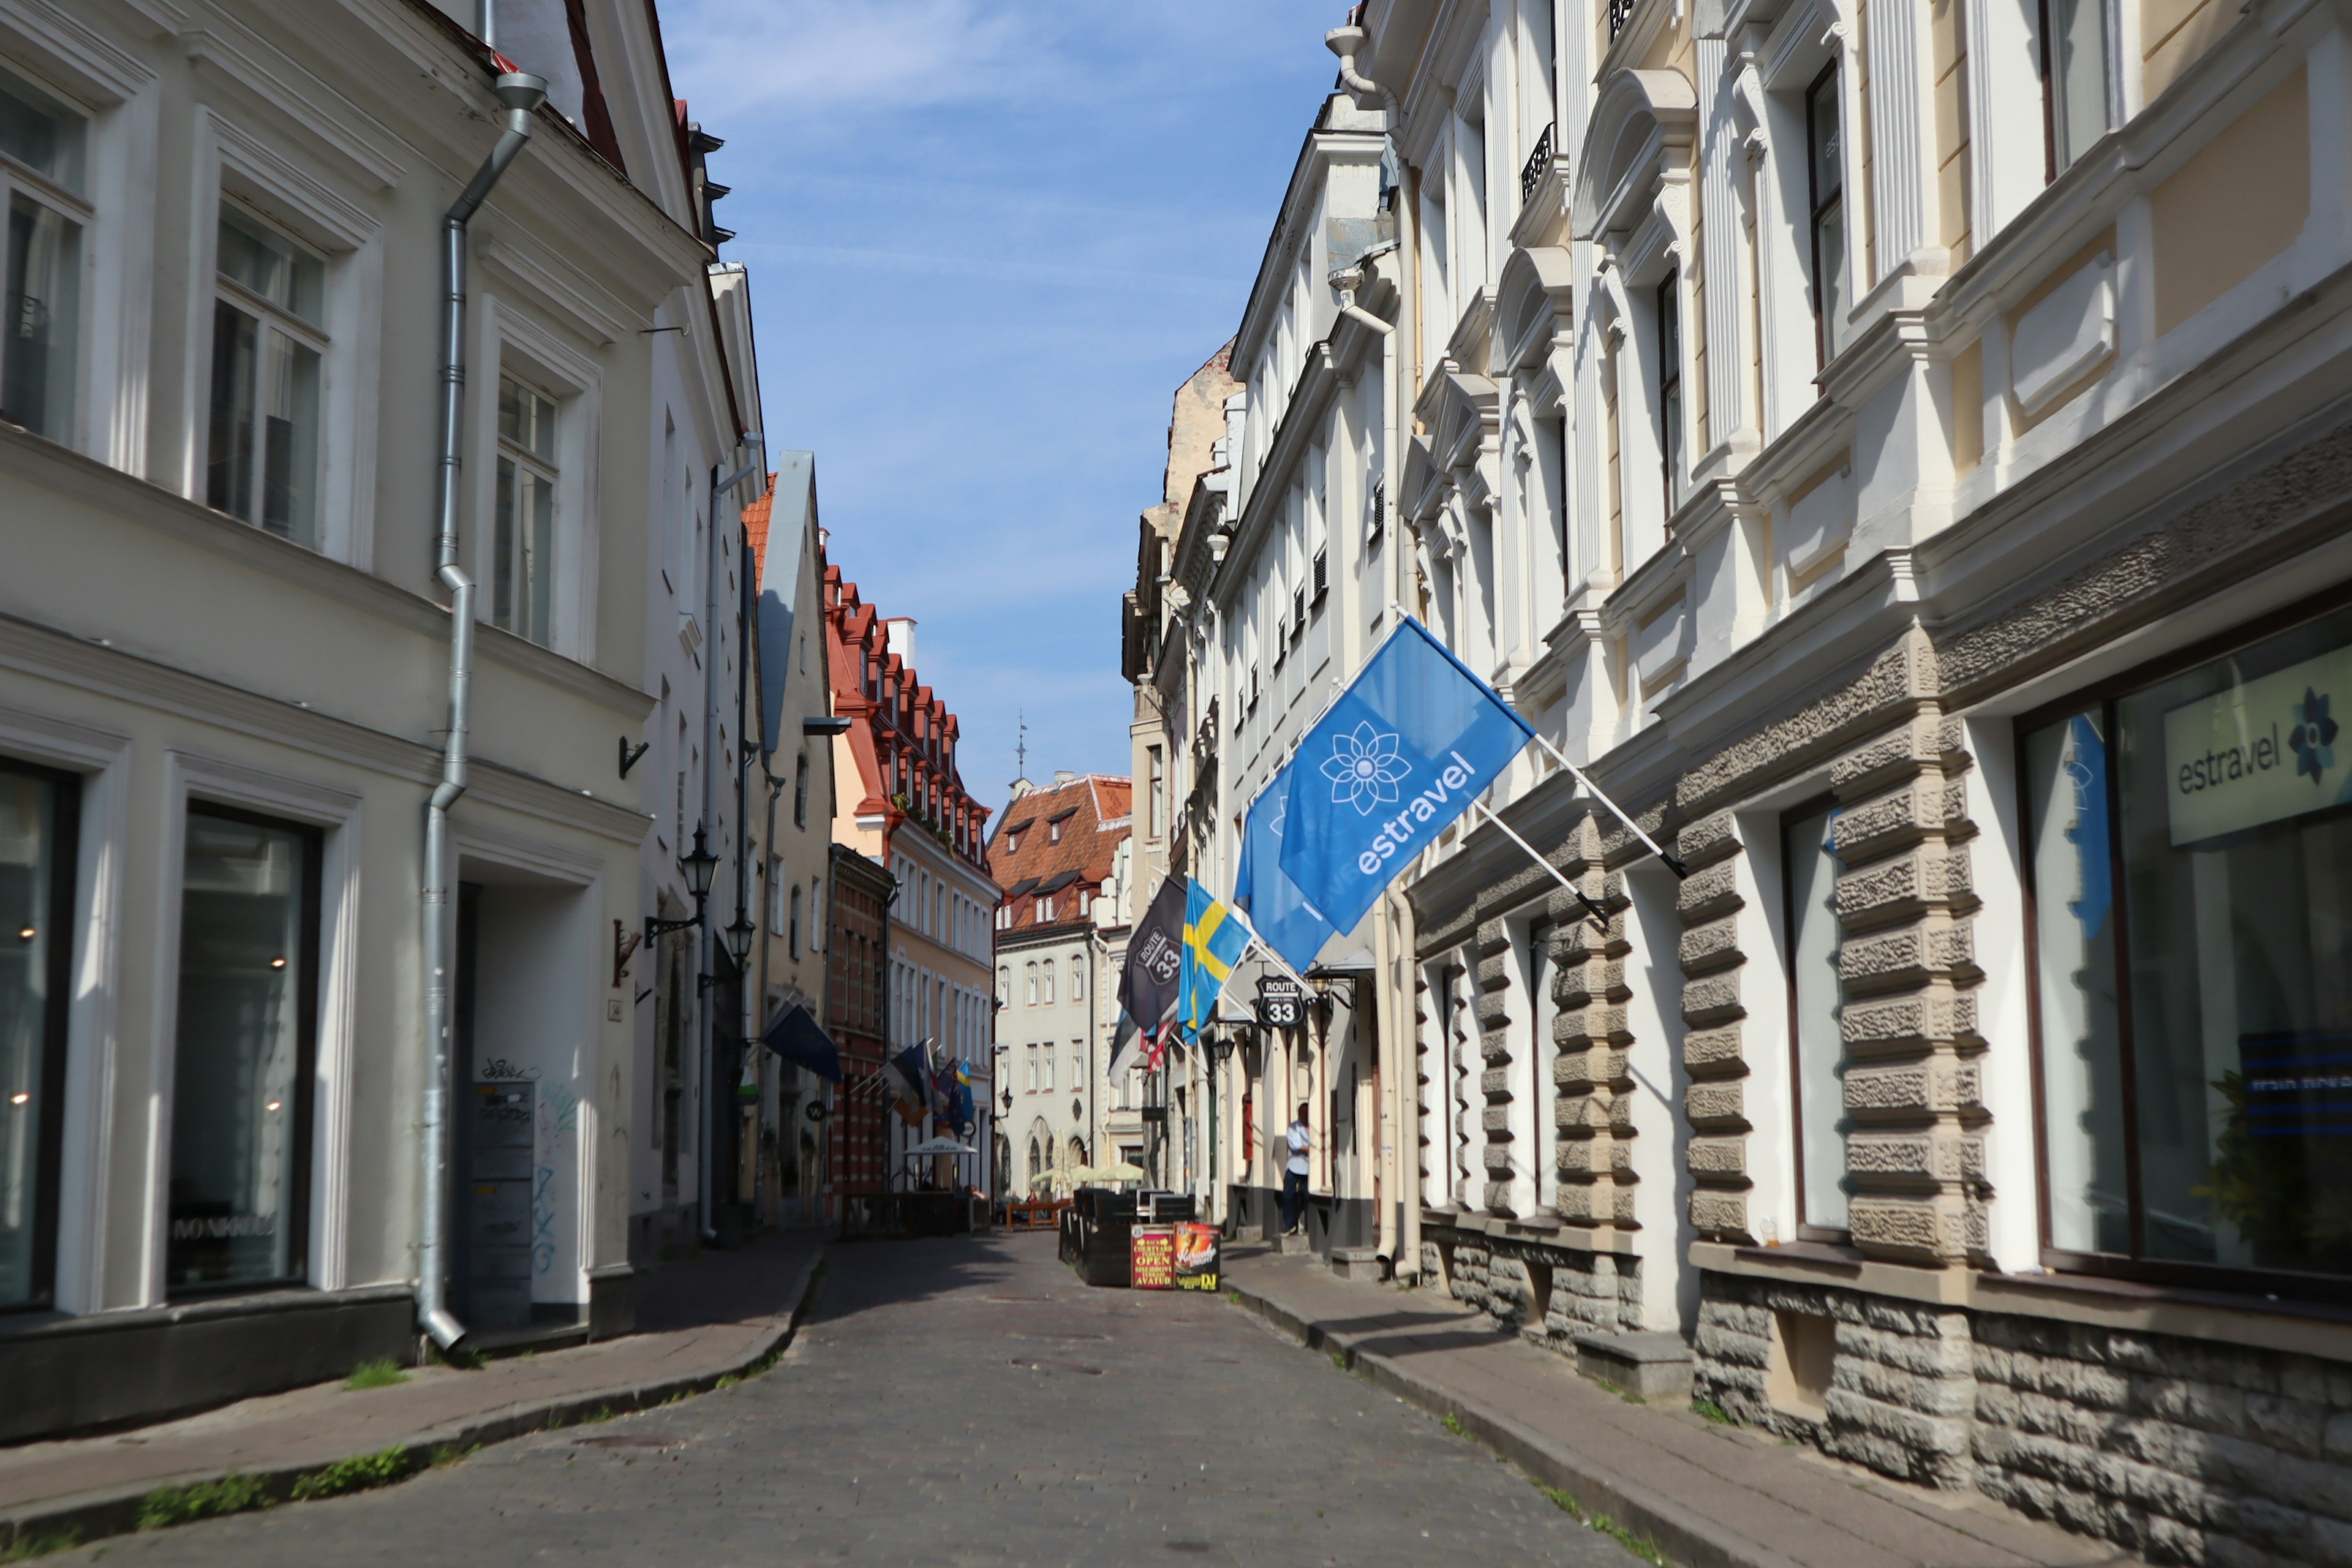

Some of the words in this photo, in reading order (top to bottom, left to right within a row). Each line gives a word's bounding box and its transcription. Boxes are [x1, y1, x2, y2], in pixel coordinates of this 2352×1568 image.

[2179, 721, 2280, 794] estravel
[1359, 750, 1476, 875] estravel
[1140, 931, 1162, 961] ROUTE
[1156, 949, 1181, 979] 33
[1266, 982, 1296, 992] ROUTE
[1269, 1003, 1295, 1022] 33
[1136, 1256, 1170, 1265] OPEN
[1136, 1276, 1171, 1285] AVATUD
[1201, 1273, 1216, 1286] DJ
